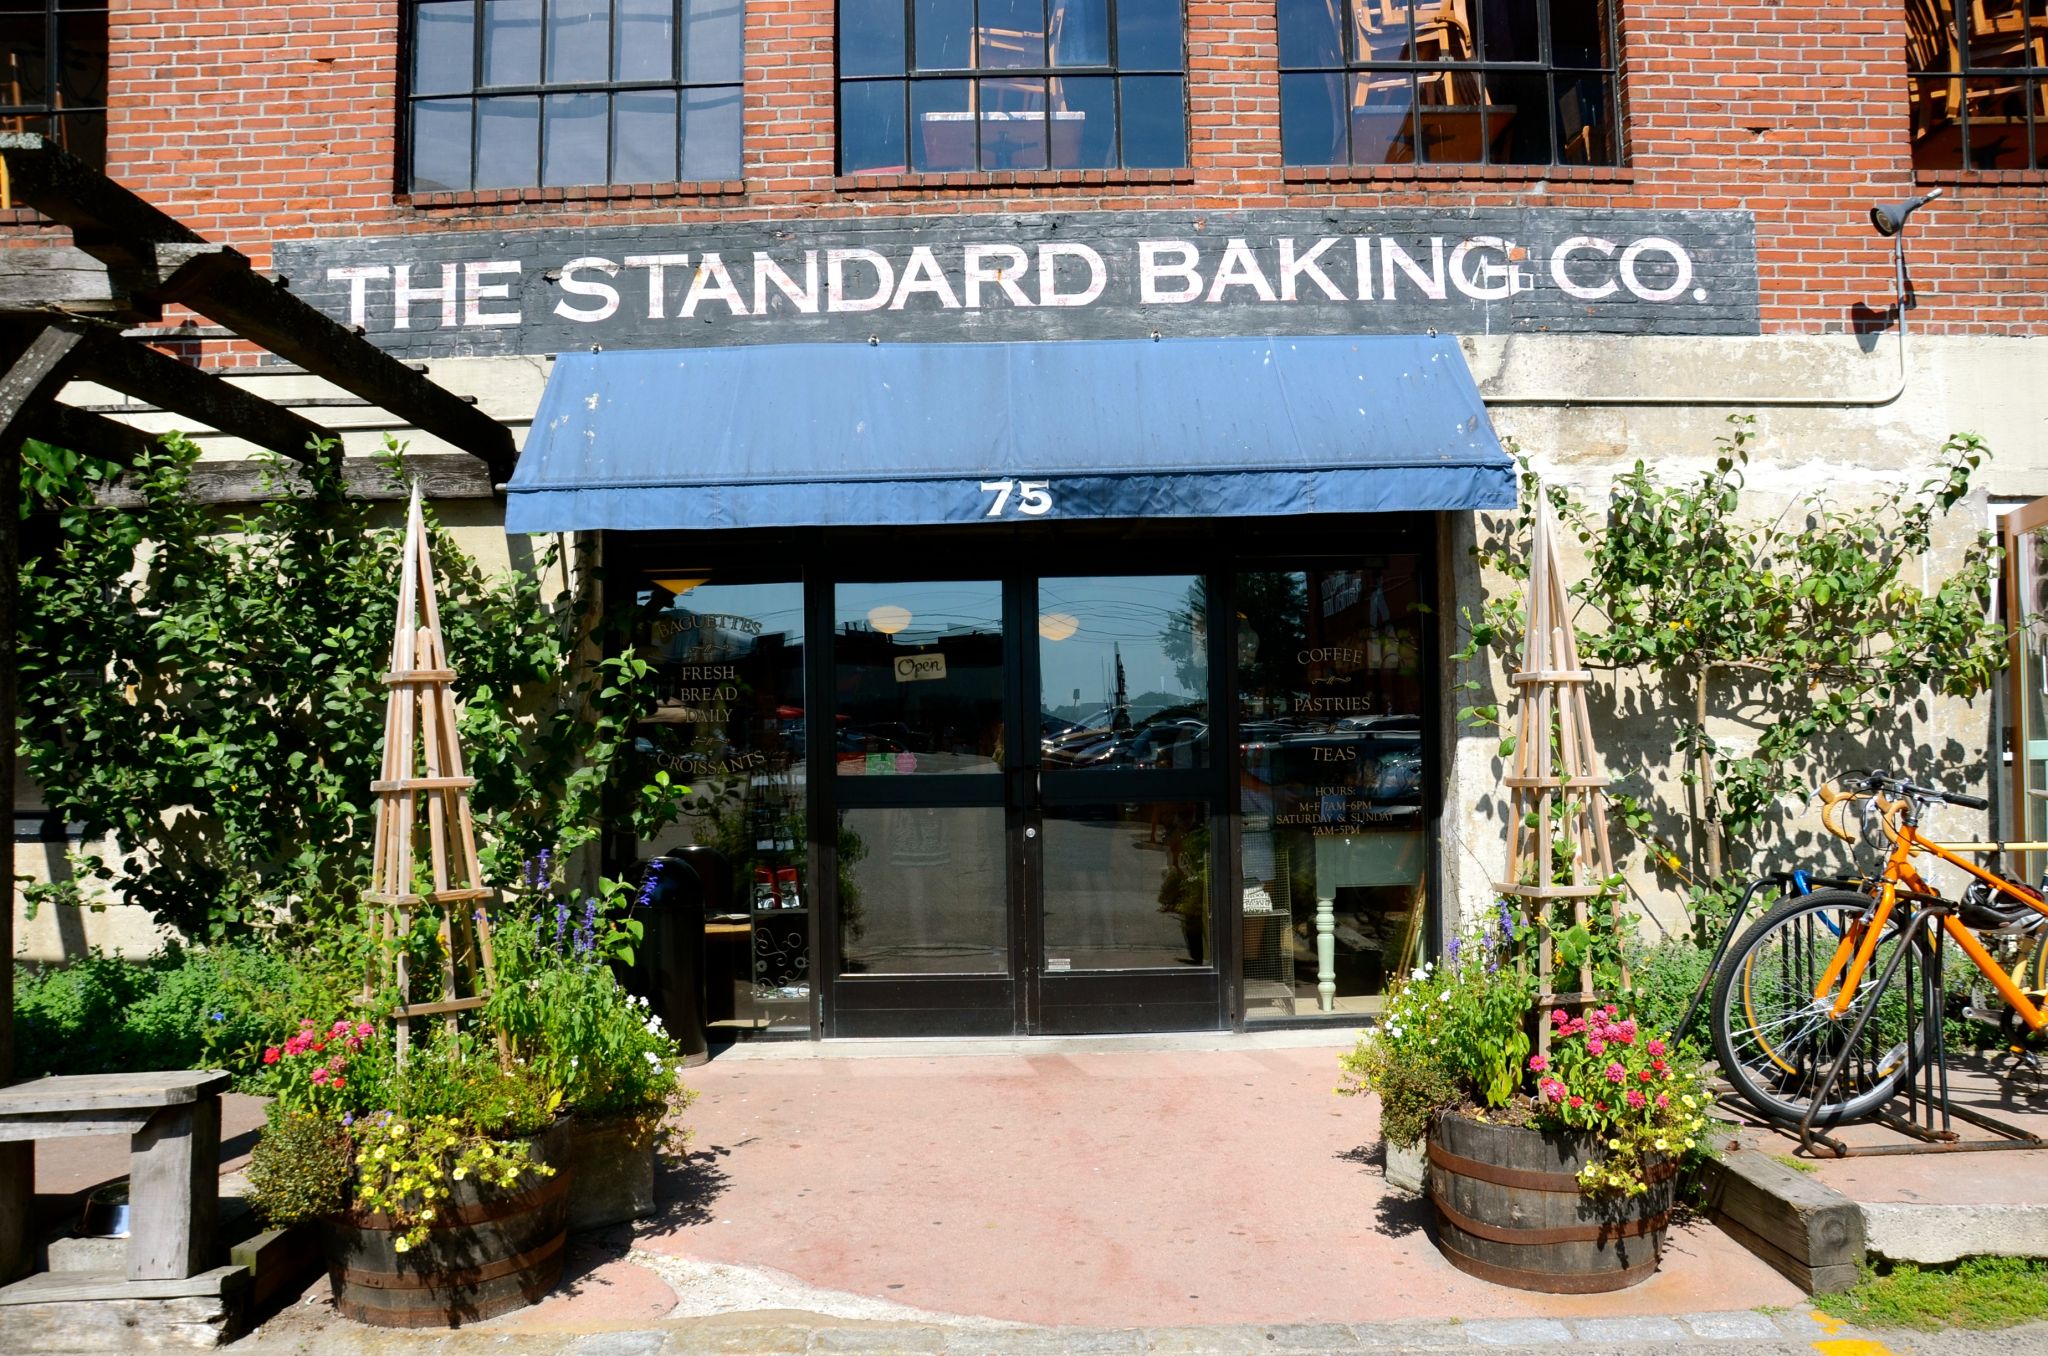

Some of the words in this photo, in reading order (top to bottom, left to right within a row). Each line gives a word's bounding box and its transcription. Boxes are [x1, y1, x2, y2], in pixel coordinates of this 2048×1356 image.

[327, 260, 522, 332] THE
[552, 241, 1107, 323] STANDARD
[1137, 236, 1534, 305] BAKING
[1550, 236, 1707, 301] CO.
[980, 479, 1053, 516] 75
[659, 614, 762, 638] BAGUETTES
[1297, 647, 1363, 665] COFFEE
[682, 665, 735, 680] FRESH
[897, 658, 943, 678] Open
[681, 686, 738, 701] BREAD
[1294, 696, 1371, 712] PASTRIES
[685, 708, 734, 723] DAILY
[657, 750, 765, 774] CROISSANTS
[1311, 746, 1357, 762] TEAS
[1315, 786, 1356, 796] HOURS:
[1299, 802, 1320, 812] M-F
[1325, 800, 1372, 811] 7AM-6PM
[1276, 813, 1332, 824] SATURDAY
[1337, 814, 1346, 823] &
[1351, 811, 1393, 822] SUNDAY
[1311, 824, 1360, 836] 7AM-5PM
